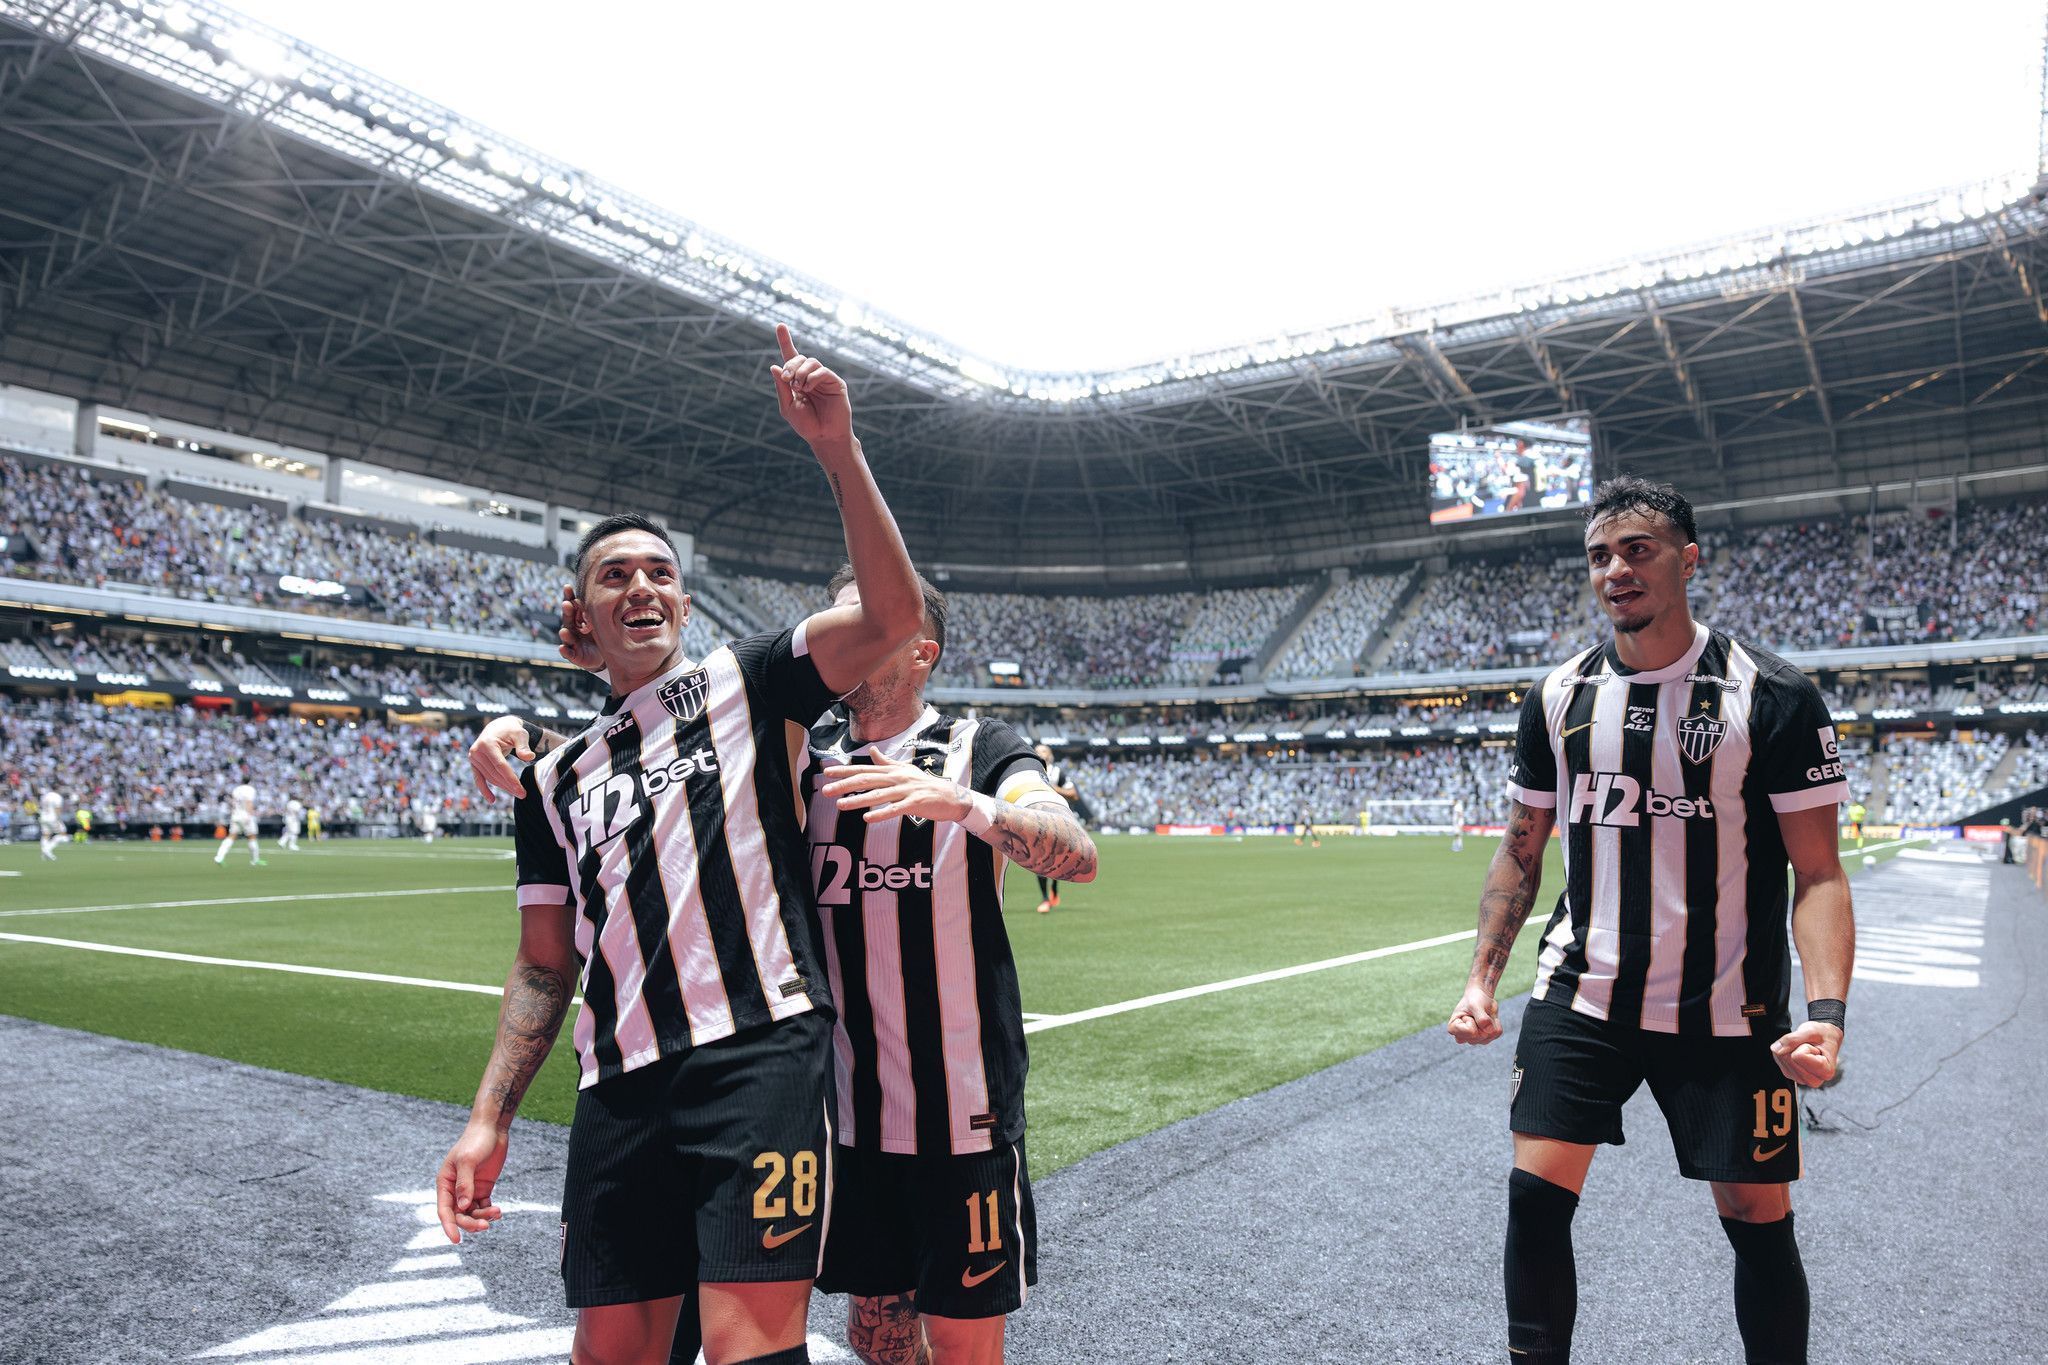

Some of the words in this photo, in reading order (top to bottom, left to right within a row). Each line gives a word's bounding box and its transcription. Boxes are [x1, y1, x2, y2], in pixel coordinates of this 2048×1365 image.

[665, 674, 702, 697] CAM
[1628, 705, 1655, 714] POSTOS
[606, 718, 634, 739] ALE
[1623, 723, 1653, 732] ALE
[1683, 721, 1720, 732] CAM
[1752, 1088, 1792, 1139] 19
[753, 1150, 818, 1219] 28
[966, 1190, 1002, 1253] 11
